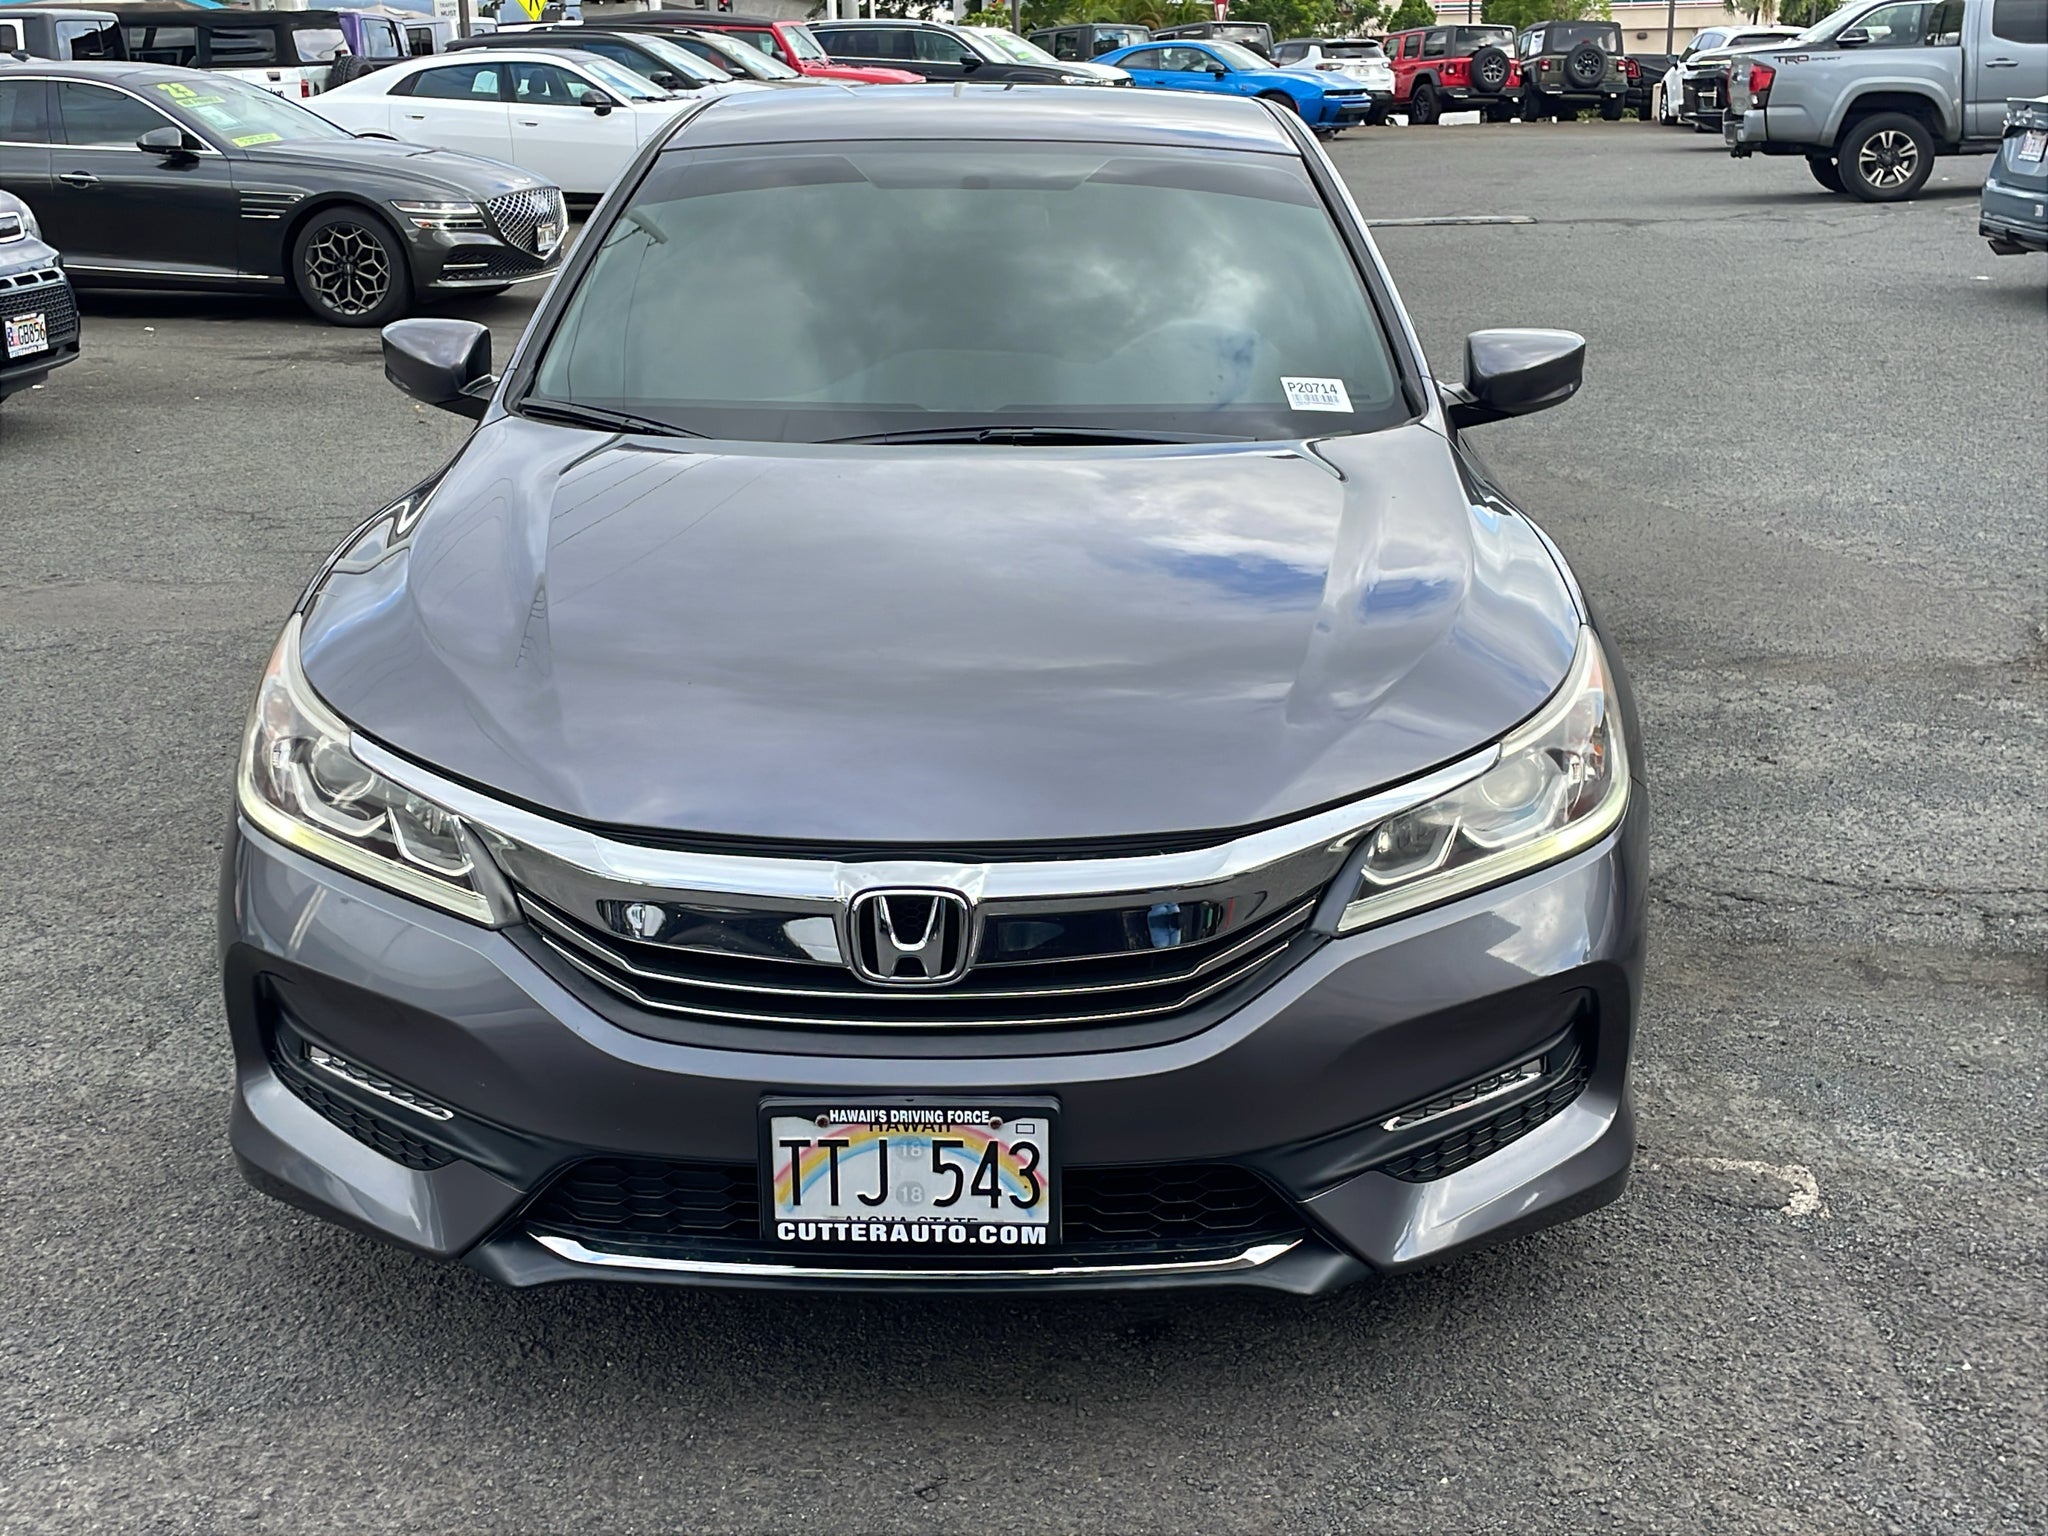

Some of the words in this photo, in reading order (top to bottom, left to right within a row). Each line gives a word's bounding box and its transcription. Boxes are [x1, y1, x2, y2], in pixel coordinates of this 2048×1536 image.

[1773, 55, 1809, 64] TRD
[1287, 382, 1338, 394] P20714
[829, 1109, 887, 1123] HAWAII'S
[890, 1110, 944, 1123] DRIVING
[947, 1110, 990, 1124] FORCE
[901, 1141, 922, 1157] 18
[779, 1139, 889, 1206] TTJ
[931, 1140, 1041, 1209] 543
[901, 1186, 923, 1202] 18
[777, 1222, 1047, 1245] CUTTERAUTO.COM
